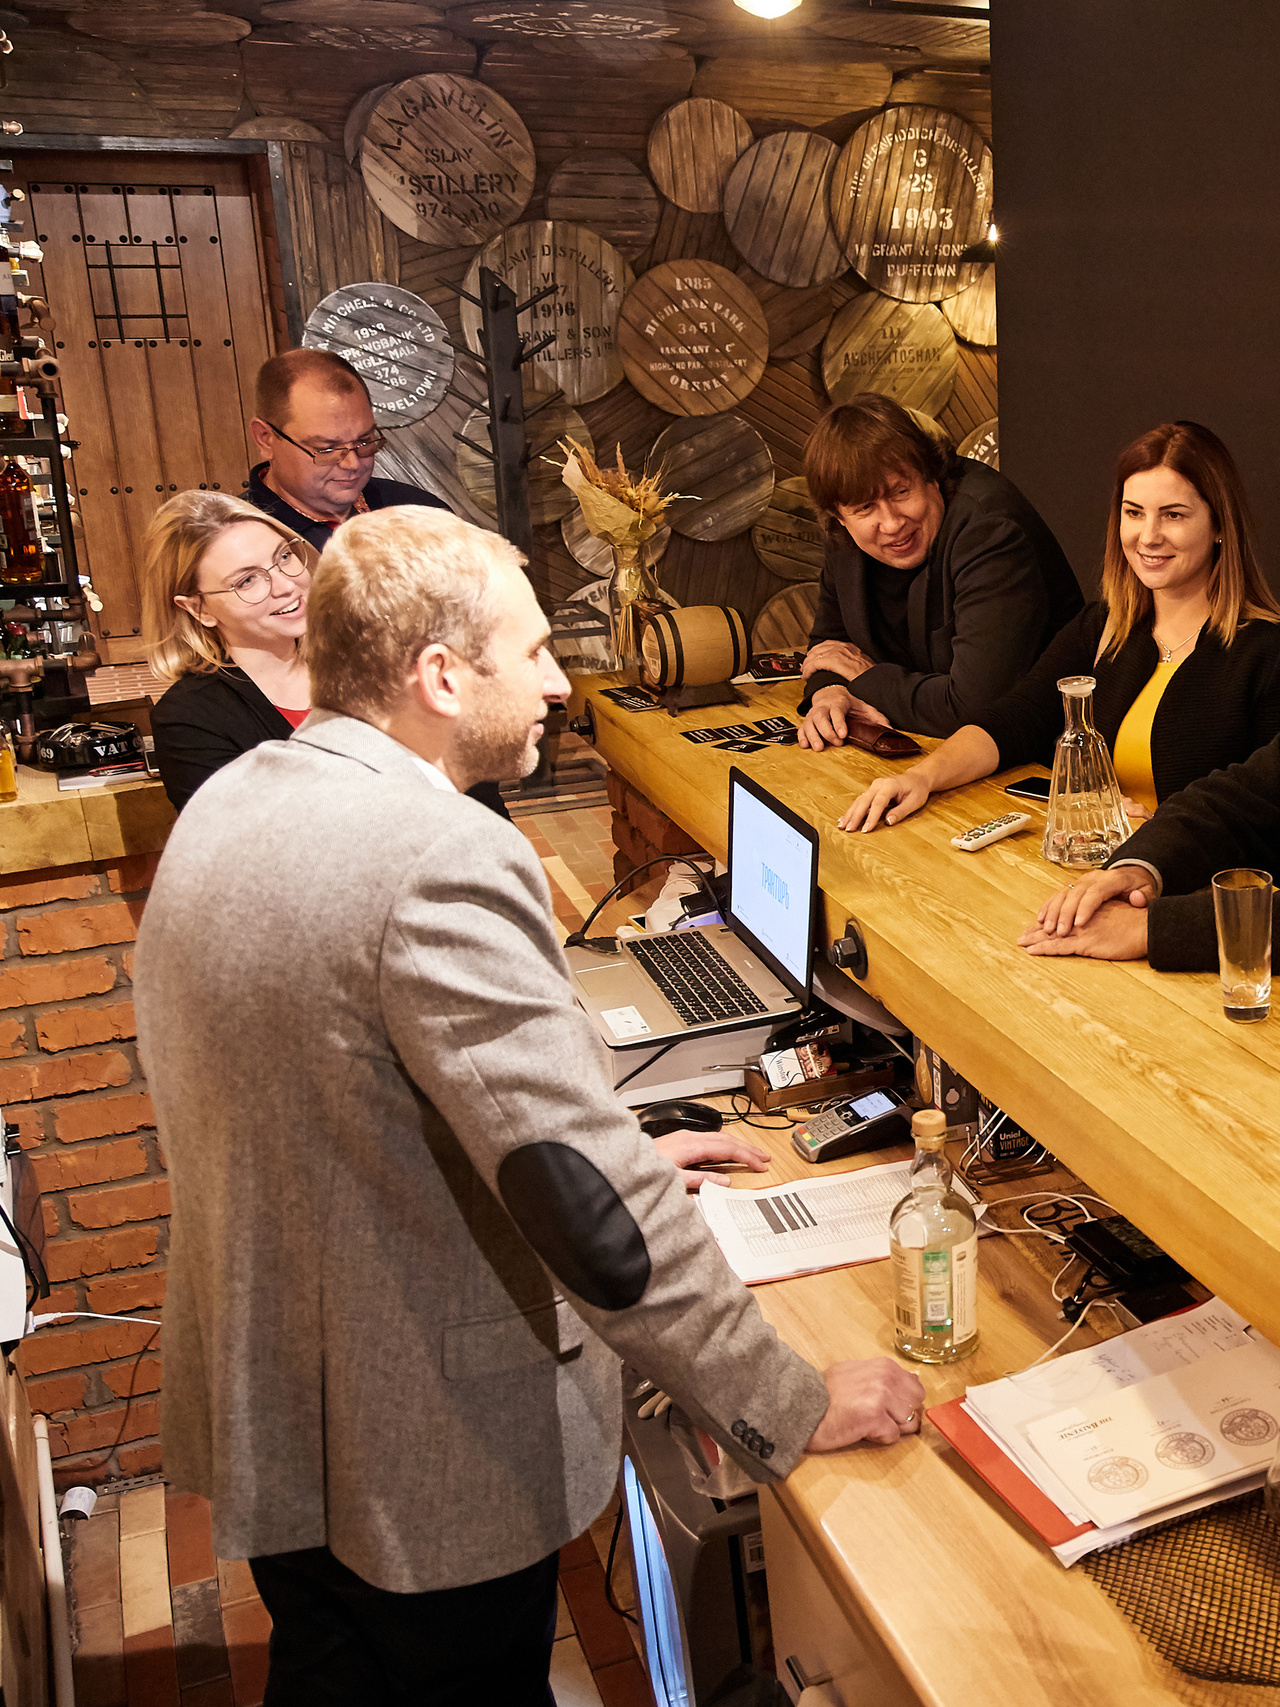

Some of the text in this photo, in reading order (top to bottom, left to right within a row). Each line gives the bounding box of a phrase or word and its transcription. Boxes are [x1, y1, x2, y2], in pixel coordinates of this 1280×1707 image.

[379, 86, 513, 150] LAGAVULIN
[424, 147, 473, 163] ISLAY
[862, 127, 935, 170] GLENFIDDICH
[913, 148, 928, 168] G
[890, 207, 955, 230] 1993
[872, 243, 913, 257] GRANT
[541, 243, 619, 295] DISTILLERY
[886, 263, 957, 278] DUFFTOWN
[675, 277, 713, 291] 1985
[321, 295, 379, 335] MITCHELL
[383, 298, 395, 309] &
[416, 321, 437, 344] LTD
[645, 298, 748, 337] HIGHLAND PARK
[567, 328, 576, 340] &
[582, 325, 612, 339] SON
[678, 321, 717, 335] 3451
[337, 330, 416, 361] SPRINGBANK
[387, 343, 419, 361] MALT
[843, 346, 942, 368] AUCHENTOSHAN
[373, 364, 400, 381] 374
[669, 371, 731, 393] ORKNEY
[40, 746, 55, 760] 69
[93, 740, 129, 758] VAT
[775, 1058, 788, 1082] Winston
[999, 1136, 1032, 1151] VINTAGE
